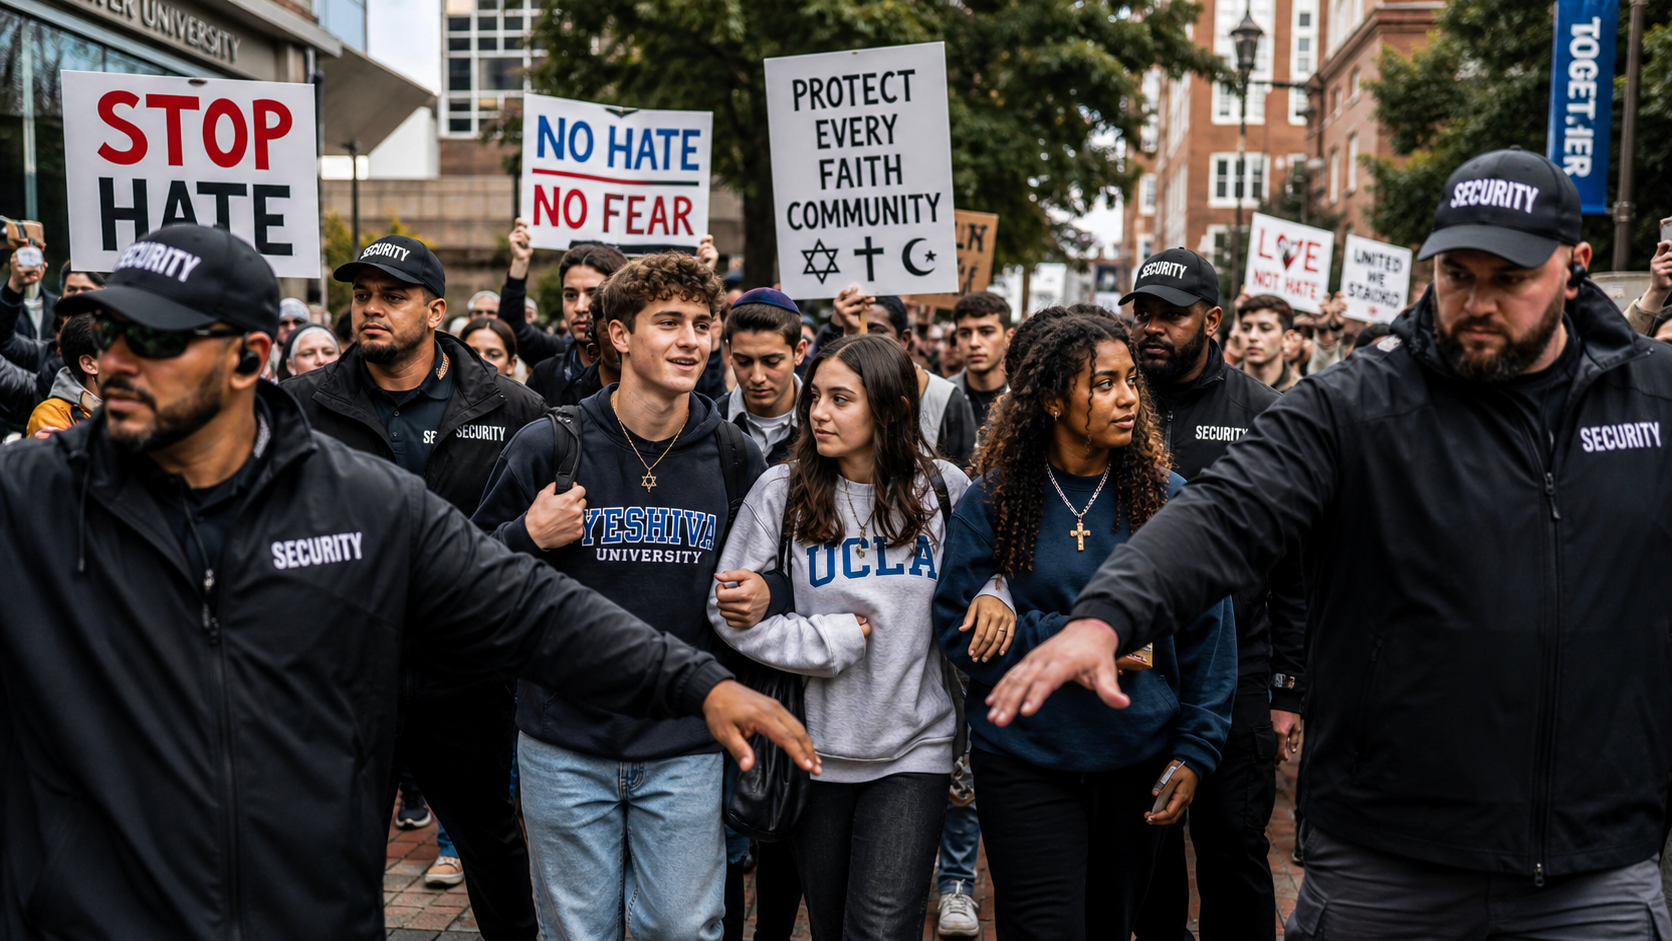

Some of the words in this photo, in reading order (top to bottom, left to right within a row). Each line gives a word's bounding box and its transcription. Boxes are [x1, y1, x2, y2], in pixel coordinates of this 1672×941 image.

[141, 0, 241, 63] UNIVERSITY
[792, 69, 916, 112] PROTECT
[97, 90, 293, 170] STOP
[537, 115, 594, 163] NO
[607, 125, 701, 171] HATE
[815, 113, 898, 150] EVERY
[819, 154, 903, 190] FAITH
[533, 184, 588, 230] NO
[602, 193, 694, 236] FEAR
[787, 192, 941, 231] COMMUNITY
[1450, 178, 1539, 214] SECURITY
[98, 177, 293, 256] HATE
[1354, 247, 1403, 274] UNITED
[1367, 270, 1386, 288] WE
[1253, 268, 1280, 292] NOT
[1285, 276, 1319, 300] HATE
[456, 424, 506, 442] SECURITY
[1580, 421, 1662, 453] SECURITY
[582, 506, 717, 550] YESHIVA
[271, 531, 362, 570] SECURITY
[596, 547, 702, 564] UNIVERSITY
[807, 534, 938, 588] UCLA
